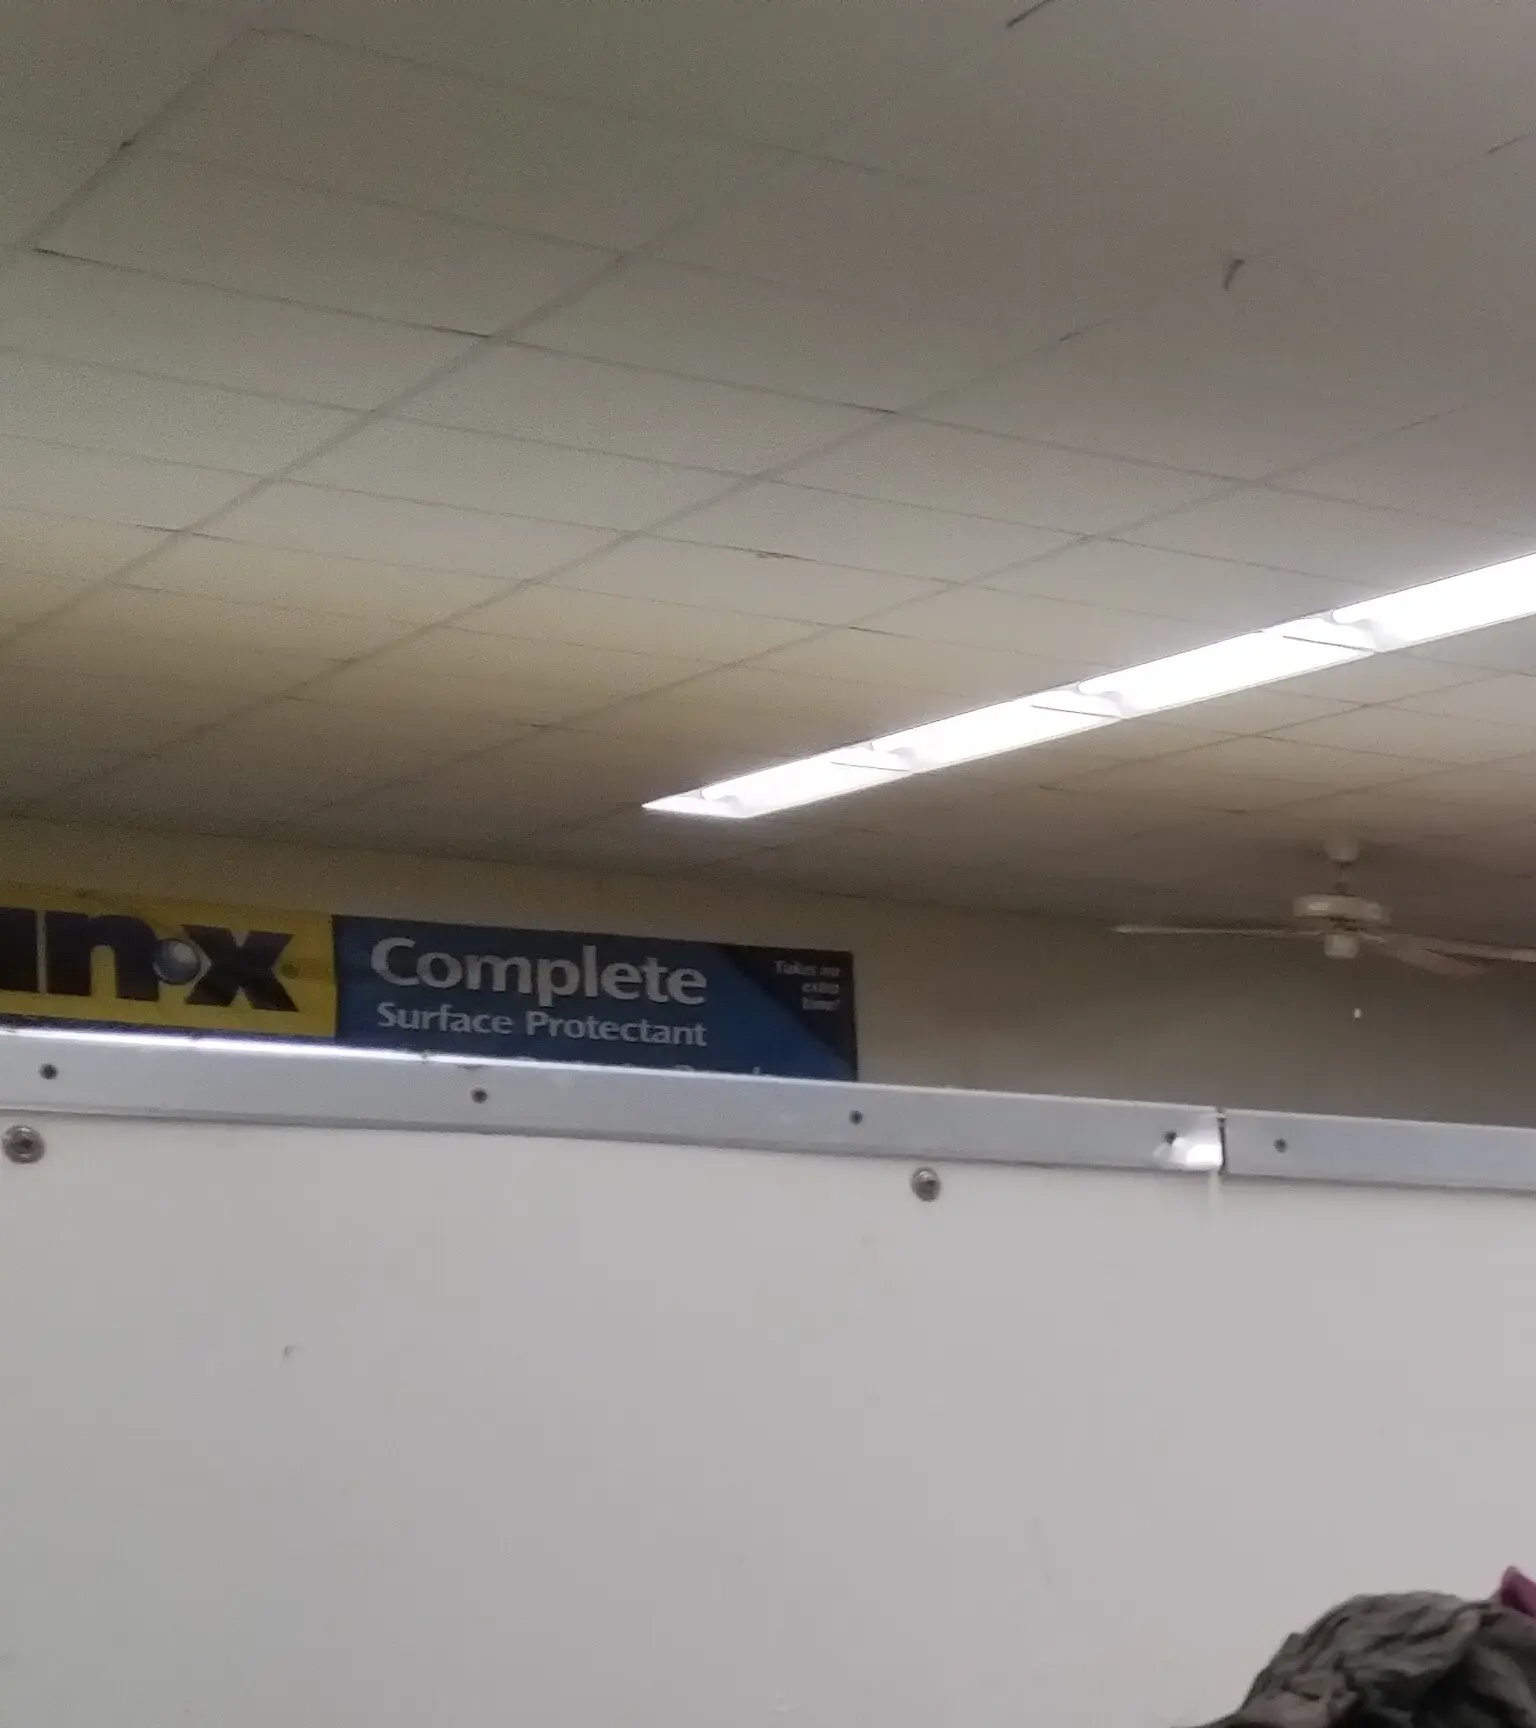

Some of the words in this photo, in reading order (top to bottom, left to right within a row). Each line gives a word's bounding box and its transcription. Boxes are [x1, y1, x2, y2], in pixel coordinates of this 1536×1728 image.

[370, 936, 707, 1007] Complete
[377, 1003, 513, 1036] Surface
[526, 1011, 708, 1048] Protectant
